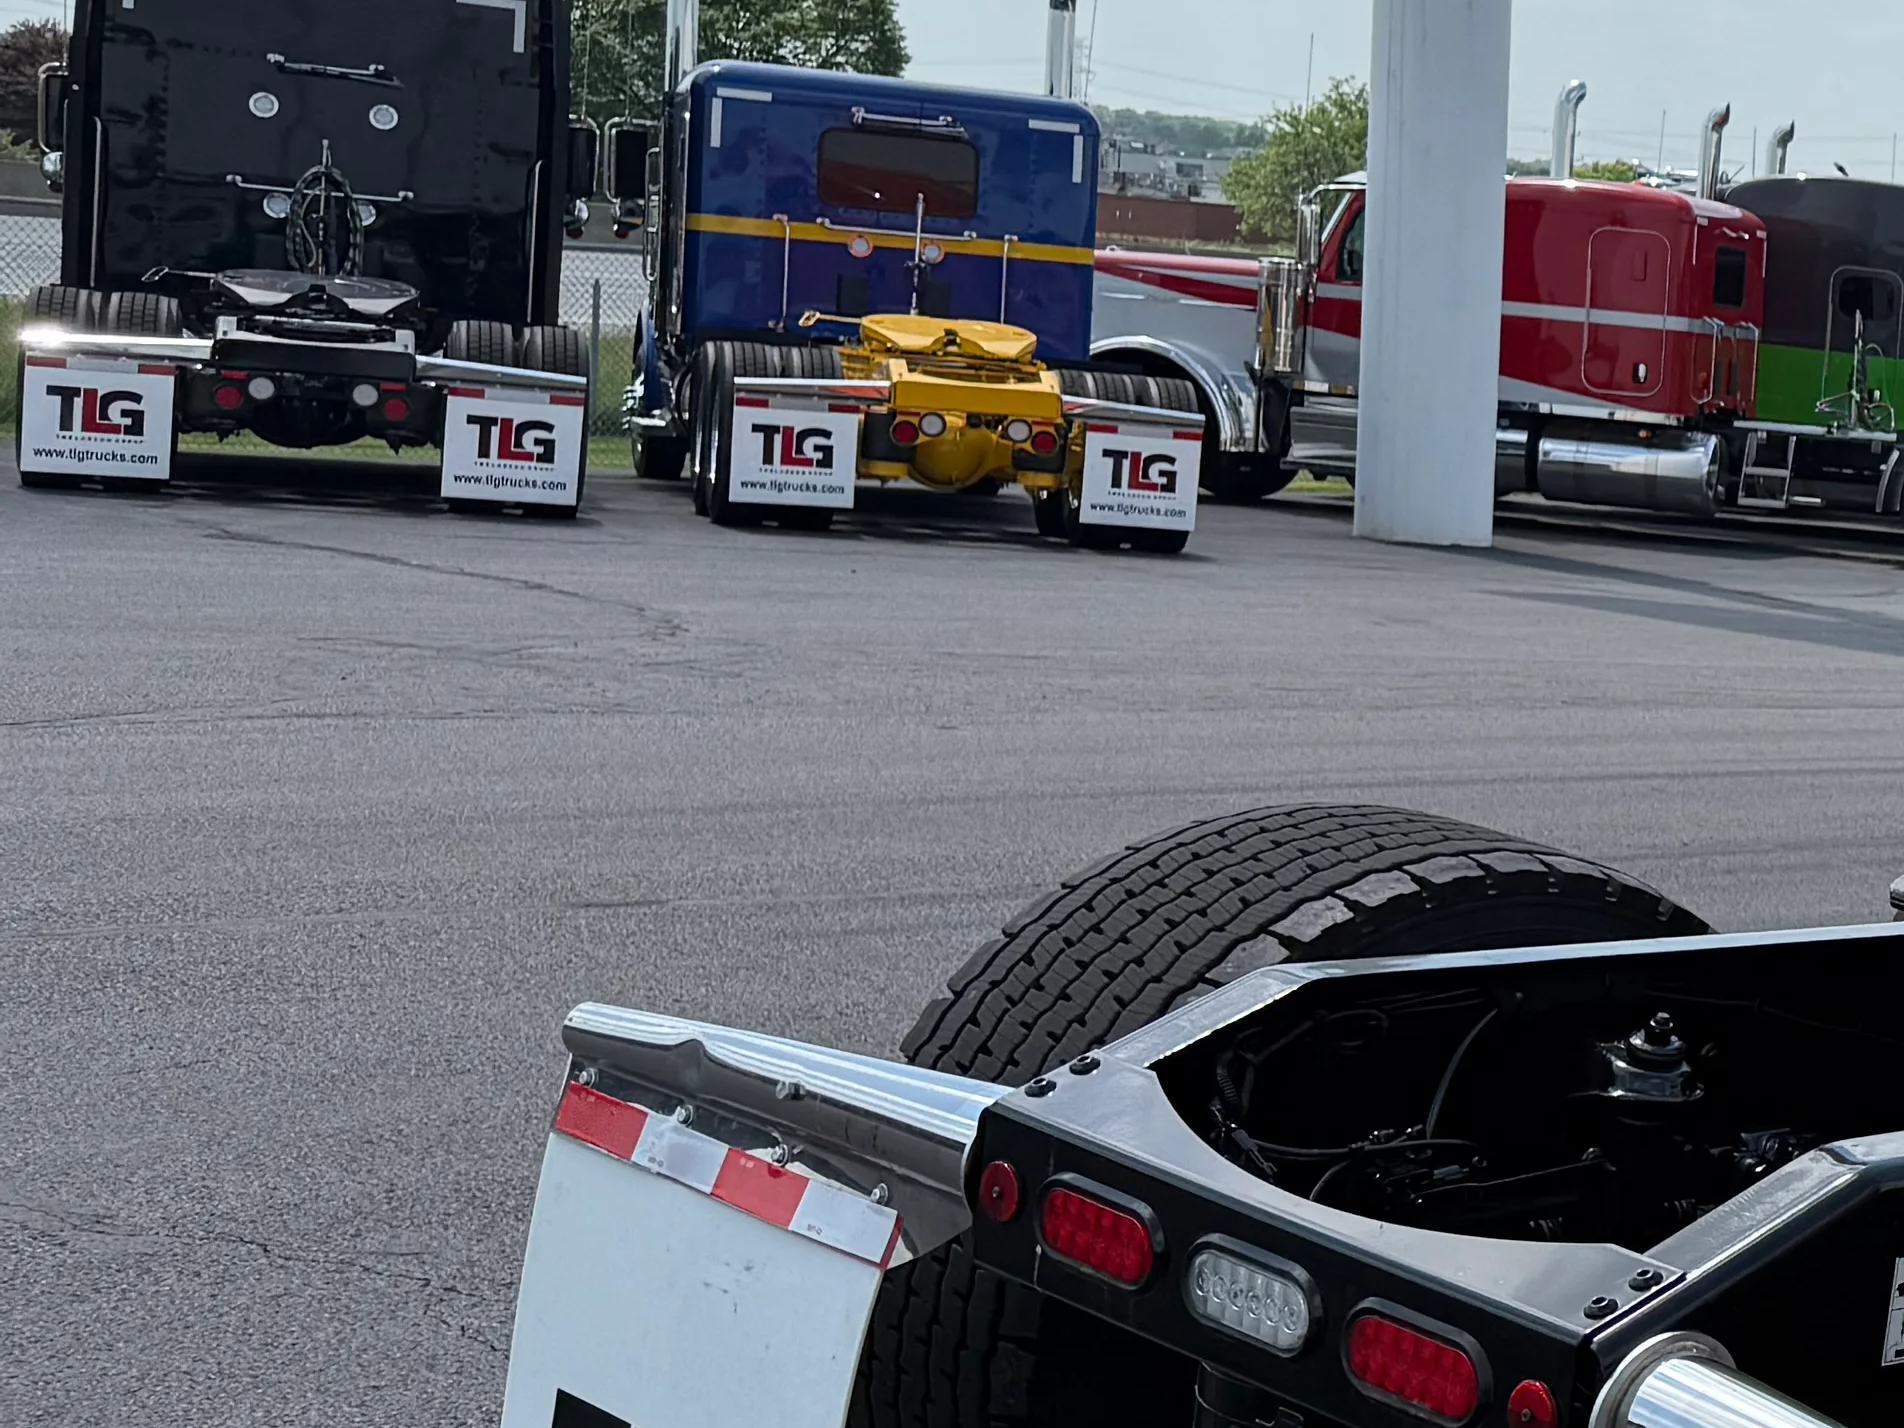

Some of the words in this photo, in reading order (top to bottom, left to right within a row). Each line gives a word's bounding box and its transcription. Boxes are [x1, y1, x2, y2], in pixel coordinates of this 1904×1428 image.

[46, 384, 145, 437] TLG
[33, 447, 158, 465] www.tlgtrucks.com
[466, 414, 556, 464] TLG
[751, 423, 834, 469] TLG
[453, 473, 567, 491] www.tlgtrucks.com
[1102, 448, 1177, 494] TLG
